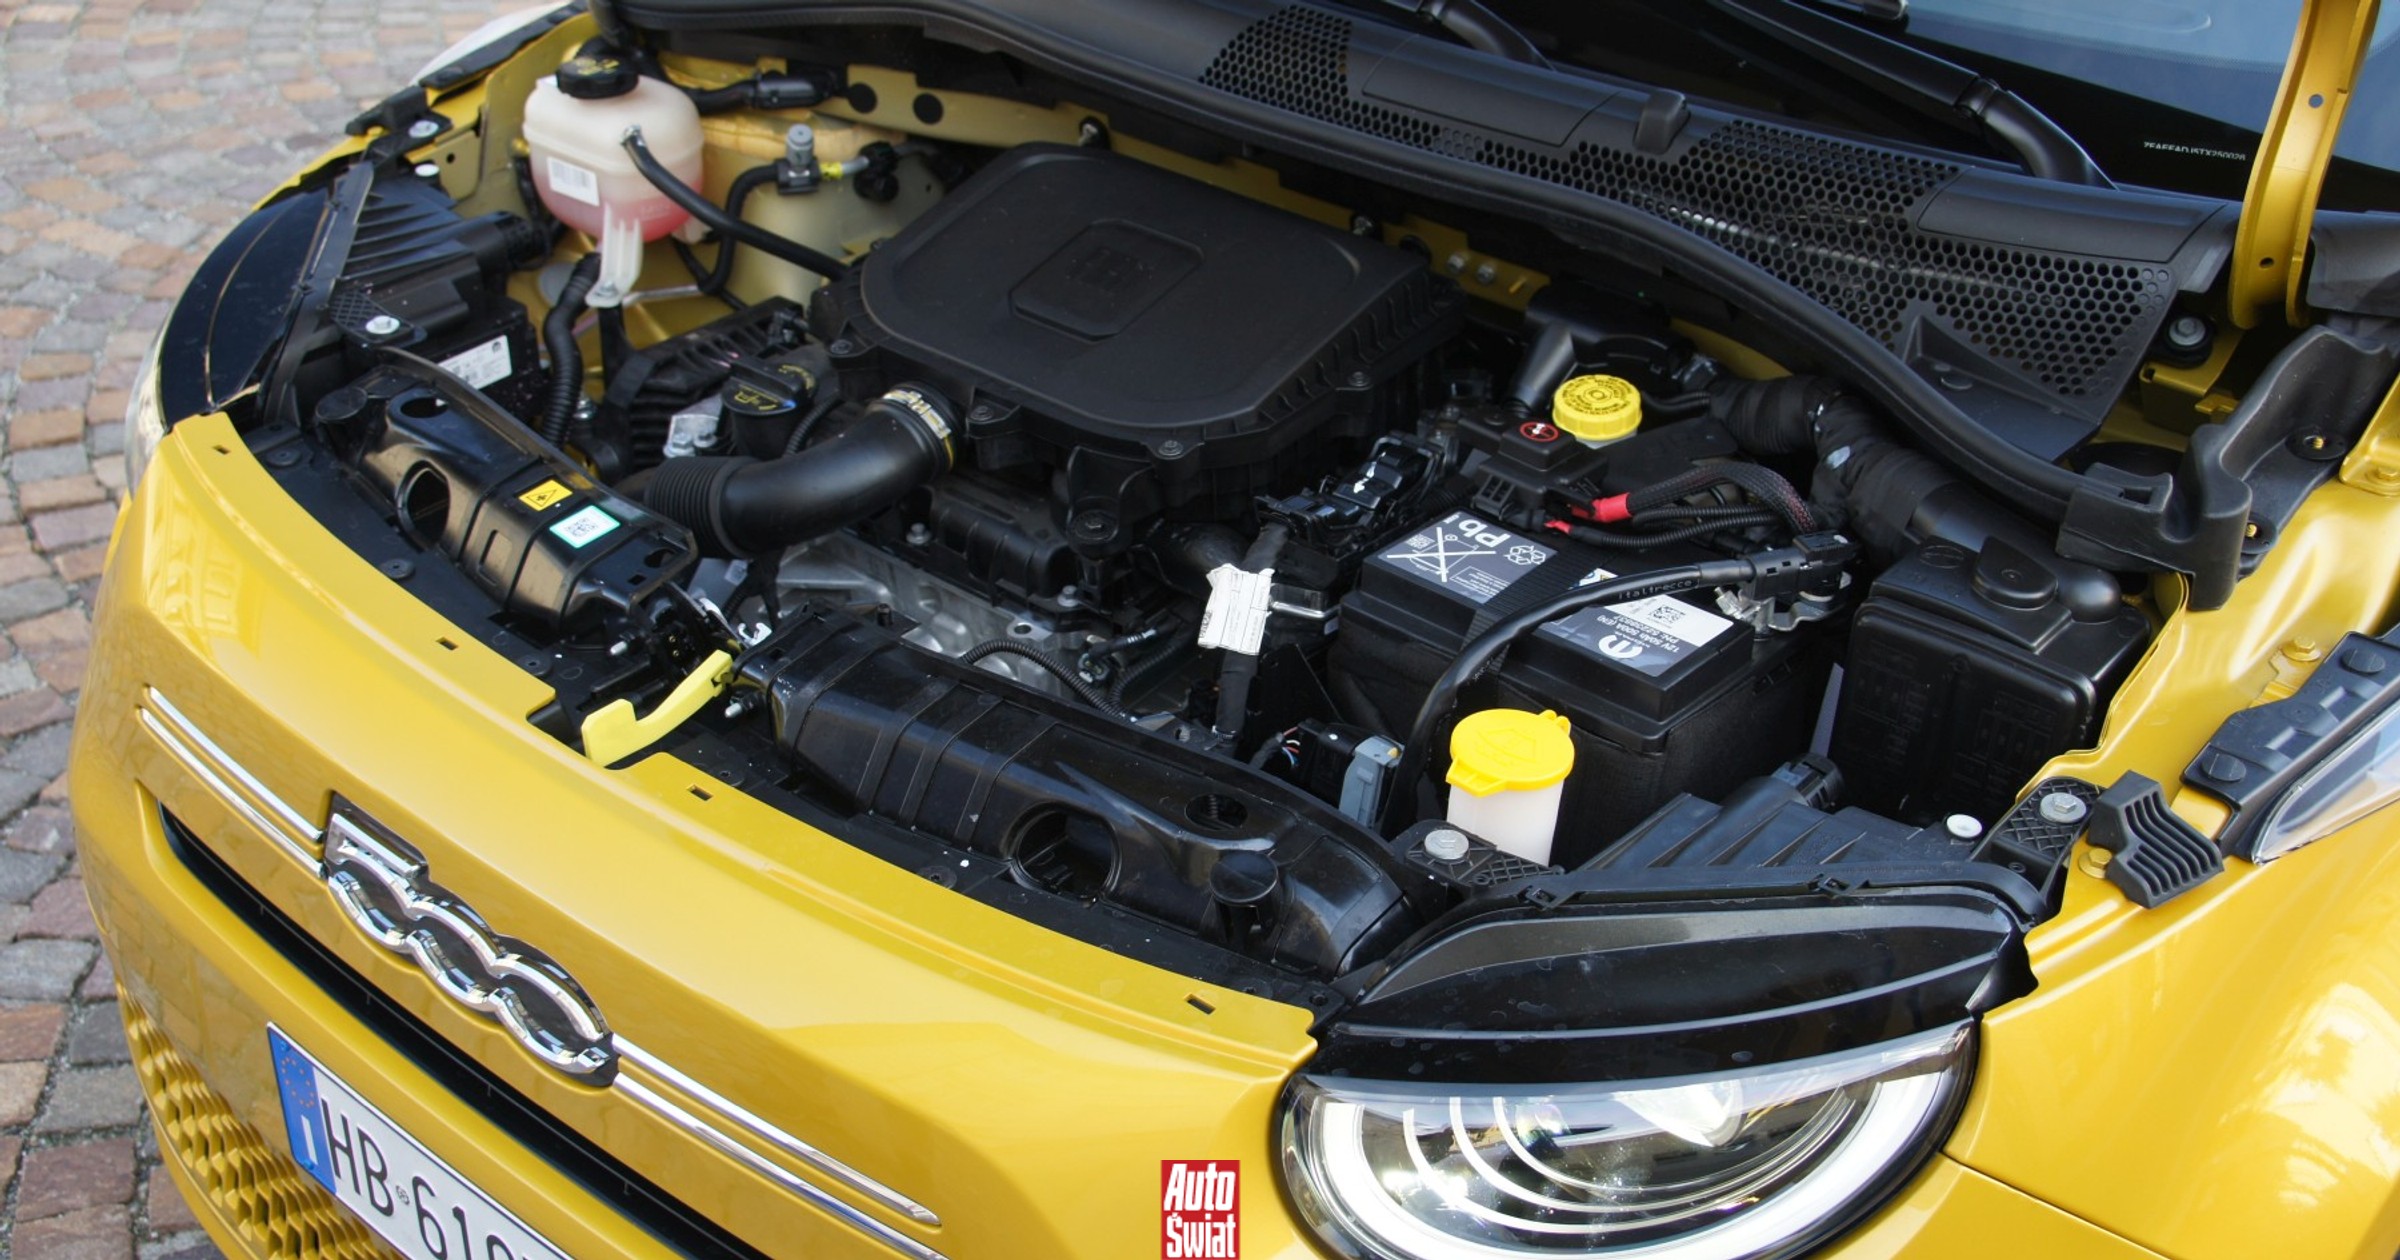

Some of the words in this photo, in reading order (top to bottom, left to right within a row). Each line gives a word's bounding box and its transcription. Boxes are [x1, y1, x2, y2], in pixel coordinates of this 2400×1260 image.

[1458, 519, 1512, 548] Pb
[328, 812, 609, 1074] 500
[321, 1097, 394, 1217] HB
